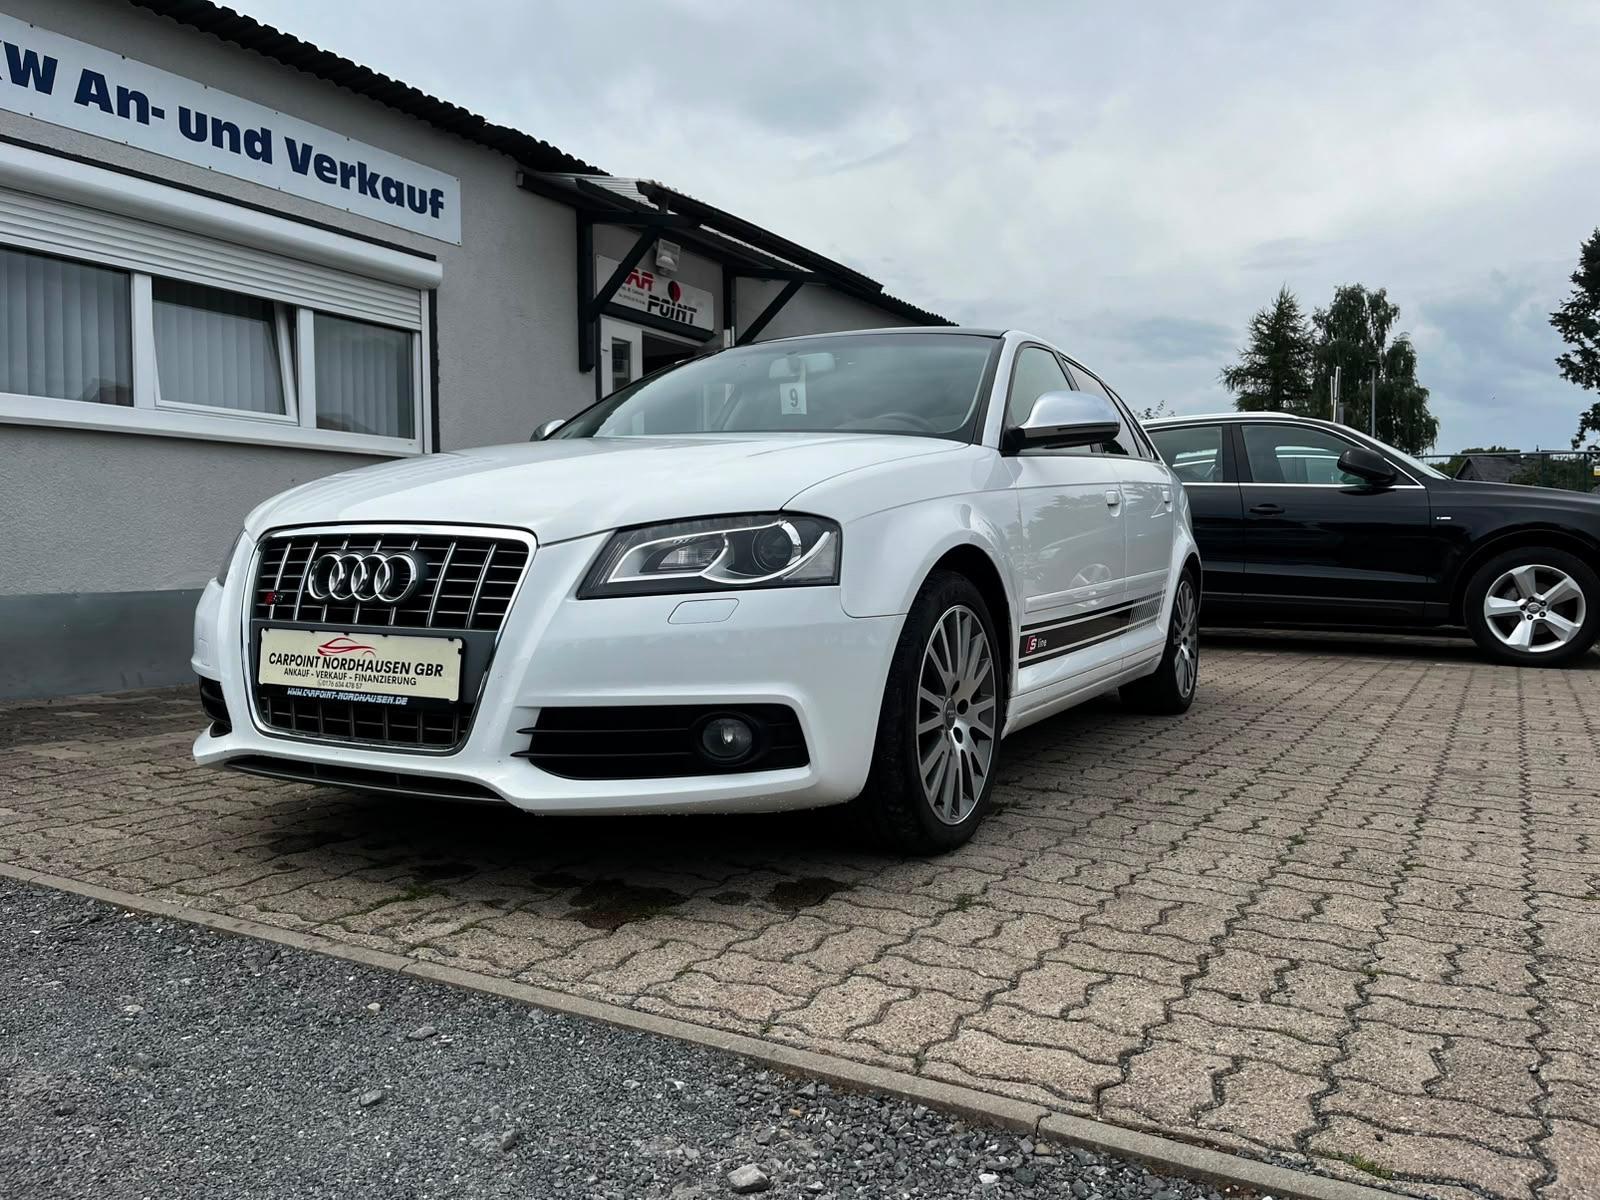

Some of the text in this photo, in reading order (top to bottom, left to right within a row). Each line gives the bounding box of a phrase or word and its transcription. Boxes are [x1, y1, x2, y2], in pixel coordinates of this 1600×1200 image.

[0, 40, 444, 218] W An- und Verkauf
[624, 268, 654, 291] AR
[647, 294, 697, 324] POINT
[789, 387, 799, 408] 9
[1038, 638, 1048, 648] line
[268, 652, 444, 678] CARPOINT NORDHAUSEN GBR
[283, 667, 310, 678] ANKAUF
[316, 670, 347, 681] VERKAUF
[354, 673, 417, 687] FINANZIERUNG
[286, 687, 409, 706] WWW.CARPOINT-NORDHAUSEN.DE
